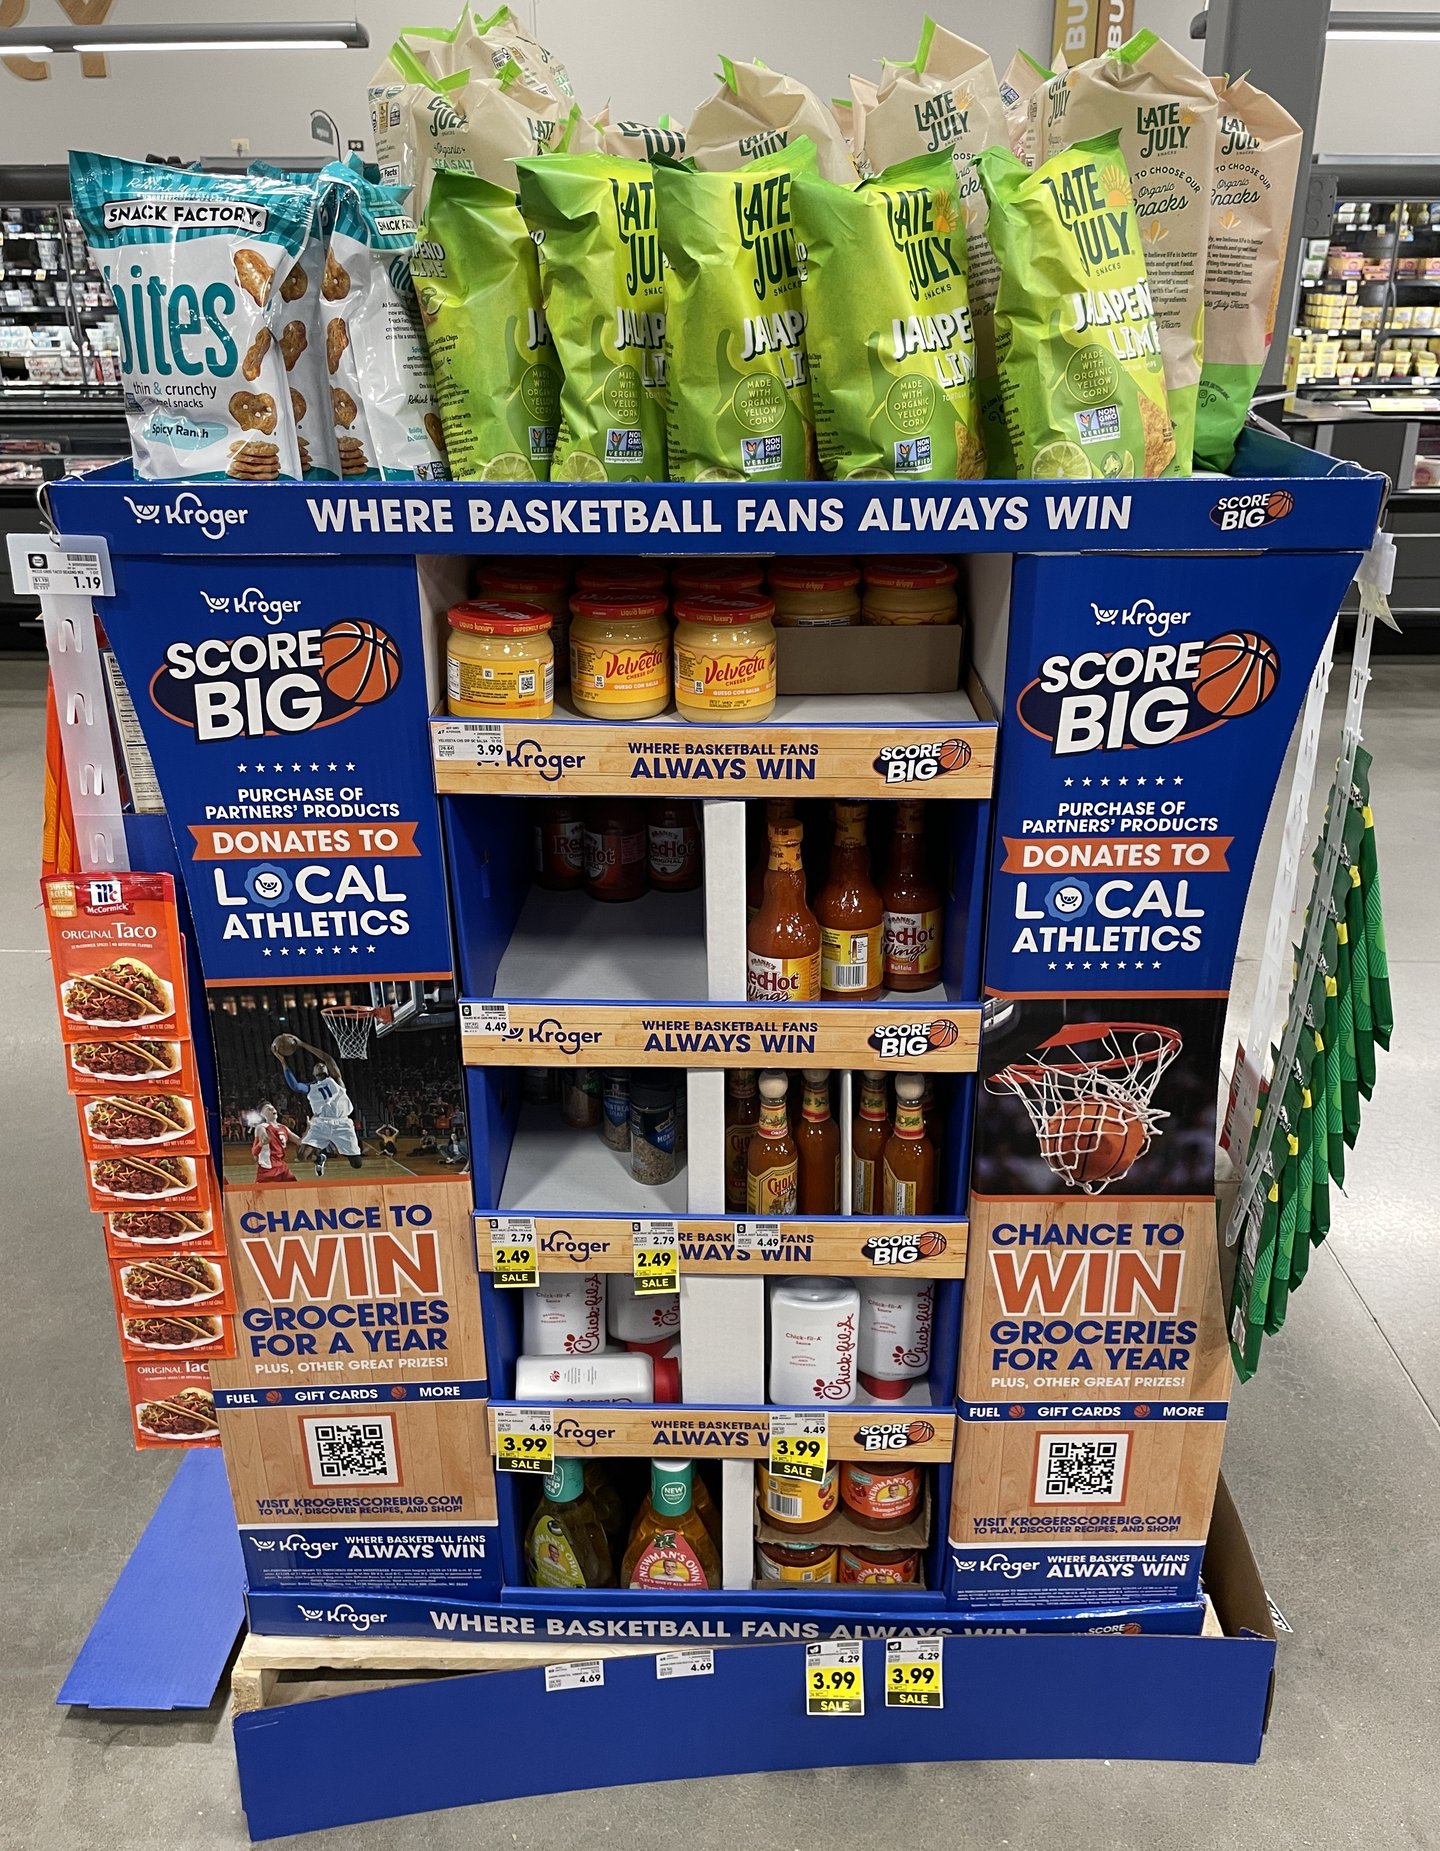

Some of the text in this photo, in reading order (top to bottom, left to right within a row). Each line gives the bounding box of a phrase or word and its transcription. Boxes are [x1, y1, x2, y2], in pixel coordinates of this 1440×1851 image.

[1137, 103, 1179, 134] LATE
[1140, 126, 1190, 158] JULY
[1135, 166, 1200, 193] TO CHOOSE OUR
[1040, 164, 1106, 231] LATE
[1138, 183, 1175, 198] Organic
[109, 205, 262, 226] SNACK FACTORY
[879, 188, 933, 252] LATE
[1073, 212, 1131, 277] JULY
[904, 237, 962, 301] JULY
[1096, 263, 1121, 276] SNACKS
[134, 382, 217, 398] thin & crunchy
[748, 379, 771, 388] MADE
[749, 389, 770, 397] WITH
[741, 397, 779, 408] ORGANIC
[744, 407, 777, 417] YELLOW
[1098, 407, 1115, 416] NON
[1099, 413, 1117, 422] GMO
[750, 416, 774, 425] CORN
[152, 424, 173, 435] Spicy
[1081, 426, 1119, 437] VERIFIED
[1218, 495, 1271, 512] SCORE
[165, 492, 1132, 539] Kroger WHERE BASKETBALL FANS ALWAYS WIN
[1221, 508, 1266, 531] BIG
[73, 576, 100, 589] 1.19
[234, 588, 301, 625] Kroger
[1122, 599, 1191, 637] Kroger
[166, 629, 324, 679] SCORE
[705, 656, 766, 685] Velveeta
[1041, 641, 1204, 693] SCORE
[726, 677, 747, 687] CHEESE
[194, 674, 322, 740] BIG
[1055, 686, 1189, 755] BIG
[477, 744, 503, 756] 3.99
[628, 742, 819, 755] WHERE BASKETBALL FANS
[881, 742, 942, 759] SCORE
[506, 739, 586, 782] Kroger
[630, 758, 816, 779] ALWAYS WIN
[886, 758, 938, 783] BIG
[238, 787, 363, 802] PURCHASE OF
[205, 803, 400, 819] PARTNERS' PRODUCTS
[1058, 801, 1186, 816] PURCHASE OF
[1022, 818, 1218, 833] PARTNERS' PRODUCTS
[212, 829, 398, 854] DONATES TO
[1023, 843, 1210, 868] DONATES TO
[86, 903, 129, 914] McCormick
[62, 922, 157, 940] ORIGINAL Taco
[223, 910, 409, 939] ATHLETICS
[1012, 926, 1202, 953] ATHLETICS
[485, 1021, 507, 1032] 4.49
[875, 1022, 932, 1036] SCORE
[529, 1019, 602, 1055] Kroger
[880, 1036, 928, 1057] BIG
[240, 1204, 432, 1233] CHANCE TO
[511, 1234, 533, 1242] 2.79
[653, 1237, 674, 1245] 2.79
[757, 1238, 778, 1247] 4.49
[867, 1234, 921, 1247] SCORE
[992, 1224, 1184, 1246] CHANCE TO
[540, 1230, 610, 1263] Kroger
[496, 1250, 530, 1263] 2.49
[637, 1253, 671, 1267] 2.49
[873, 1248, 918, 1265] BIG
[240, 1230, 443, 1303] WIN
[501, 1273, 529, 1282] SALE
[642, 1279, 669, 1287] SALE
[988, 1250, 1185, 1317] WIN
[243, 1300, 449, 1332] GROCERIES
[990, 1320, 1198, 1345] GROCERIES
[250, 1328, 448, 1357] FOR A YEAR
[824, 1314, 855, 1400] Chick-fil-A
[992, 1348, 1189, 1370] FOR A YEAR
[255, 1357, 448, 1375] PLUS, OTHER GREAT PRIZES!
[226, 1386, 460, 1404] FUEL GIFT CARDS MORE
[529, 1424, 551, 1432] 4.49
[803, 1426, 825, 1434] 4.49
[860, 1424, 910, 1435] SCORE
[503, 1438, 547, 1452] 3.99
[777, 1440, 820, 1456] 3.99
[865, 1434, 908, 1450] BIG
[511, 1460, 540, 1469] SALE
[784, 1465, 813, 1477] SALE
[256, 1496, 463, 1508] VISIT KROGERSCOREBIG.COM
[276, 1508, 302, 1516] PLAY,
[305, 1507, 356, 1515] DISCOVER
[359, 1506, 403, 1514] RECIPES,
[406, 1505, 427, 1513] AND
[431, 1504, 462, 1513] SHOP!
[279, 1534, 338, 1559] Kroger
[345, 1535, 485, 1544] WHERE BASKETBALL FANS
[348, 1544, 485, 1559] ALWAYS WIN
[639, 1551, 700, 1582] NEWMAN'S OWN
[327, 1604, 819, 1639] Kroger WHERE BASKETBALL FANS
[690, 1663, 712, 1671] 4.69
[838, 1655, 859, 1663] 4.29
[580, 1675, 600, 1683] 4.69
[814, 1672, 855, 1689] 3.99
[892, 1668, 934, 1684] 3.99
[821, 1701, 850, 1711] SALE
[900, 1694, 928, 1704] SALE
